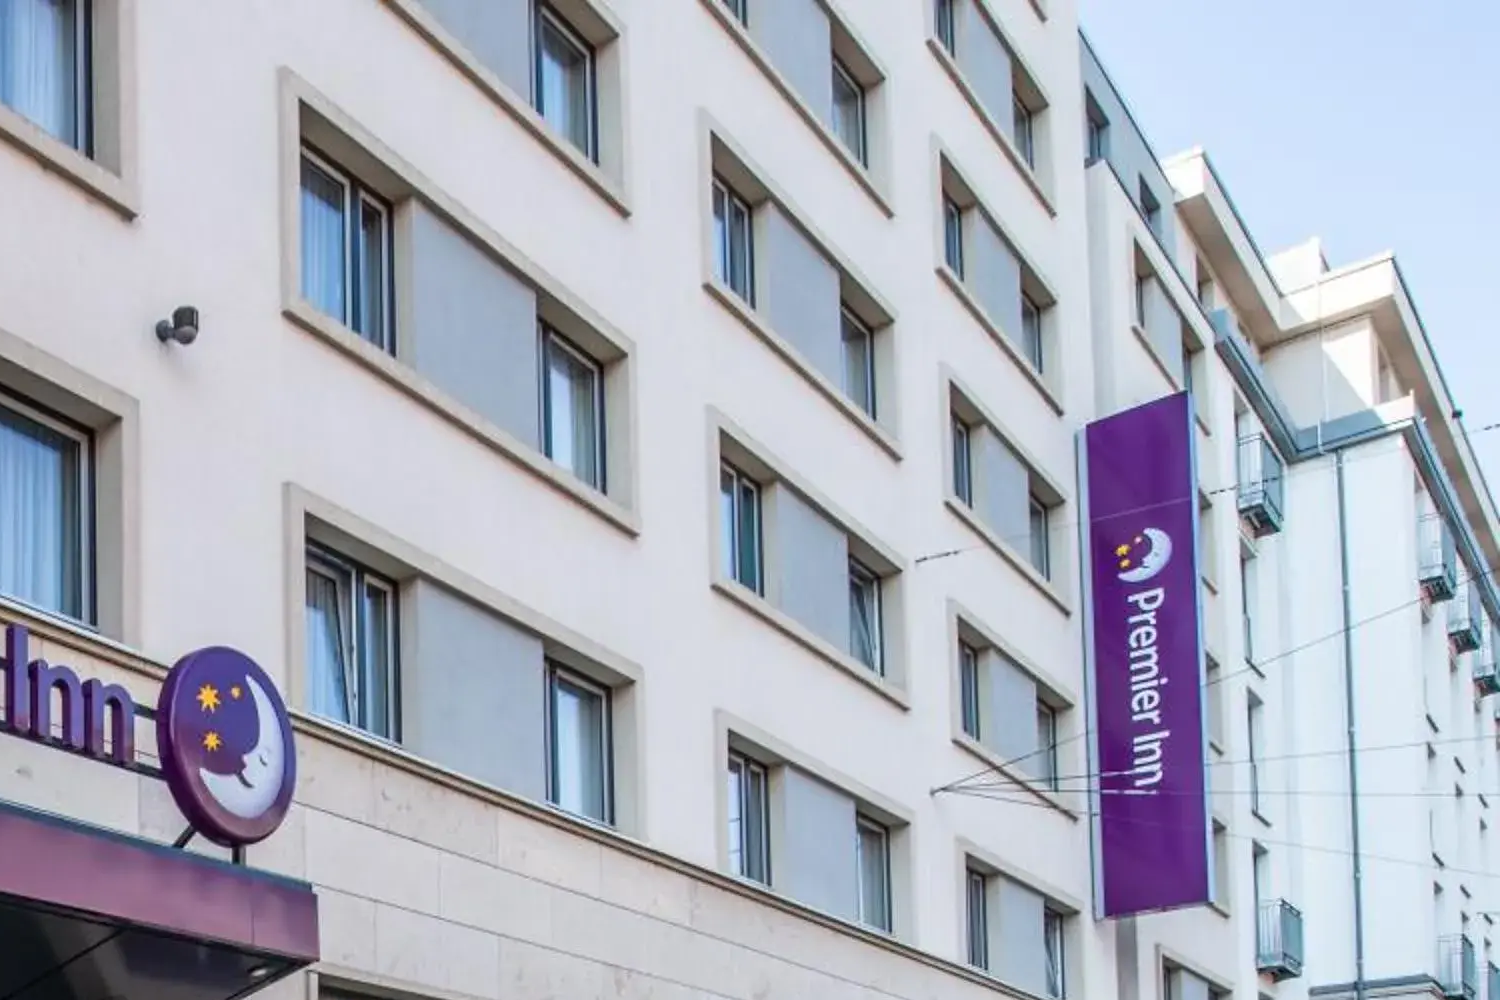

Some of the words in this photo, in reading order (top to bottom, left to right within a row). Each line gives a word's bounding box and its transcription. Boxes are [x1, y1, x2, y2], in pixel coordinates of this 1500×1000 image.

[5, 623, 138, 766] Inn
[1127, 587, 1169, 725] Premier
[1132, 729, 1171, 787] Inn
